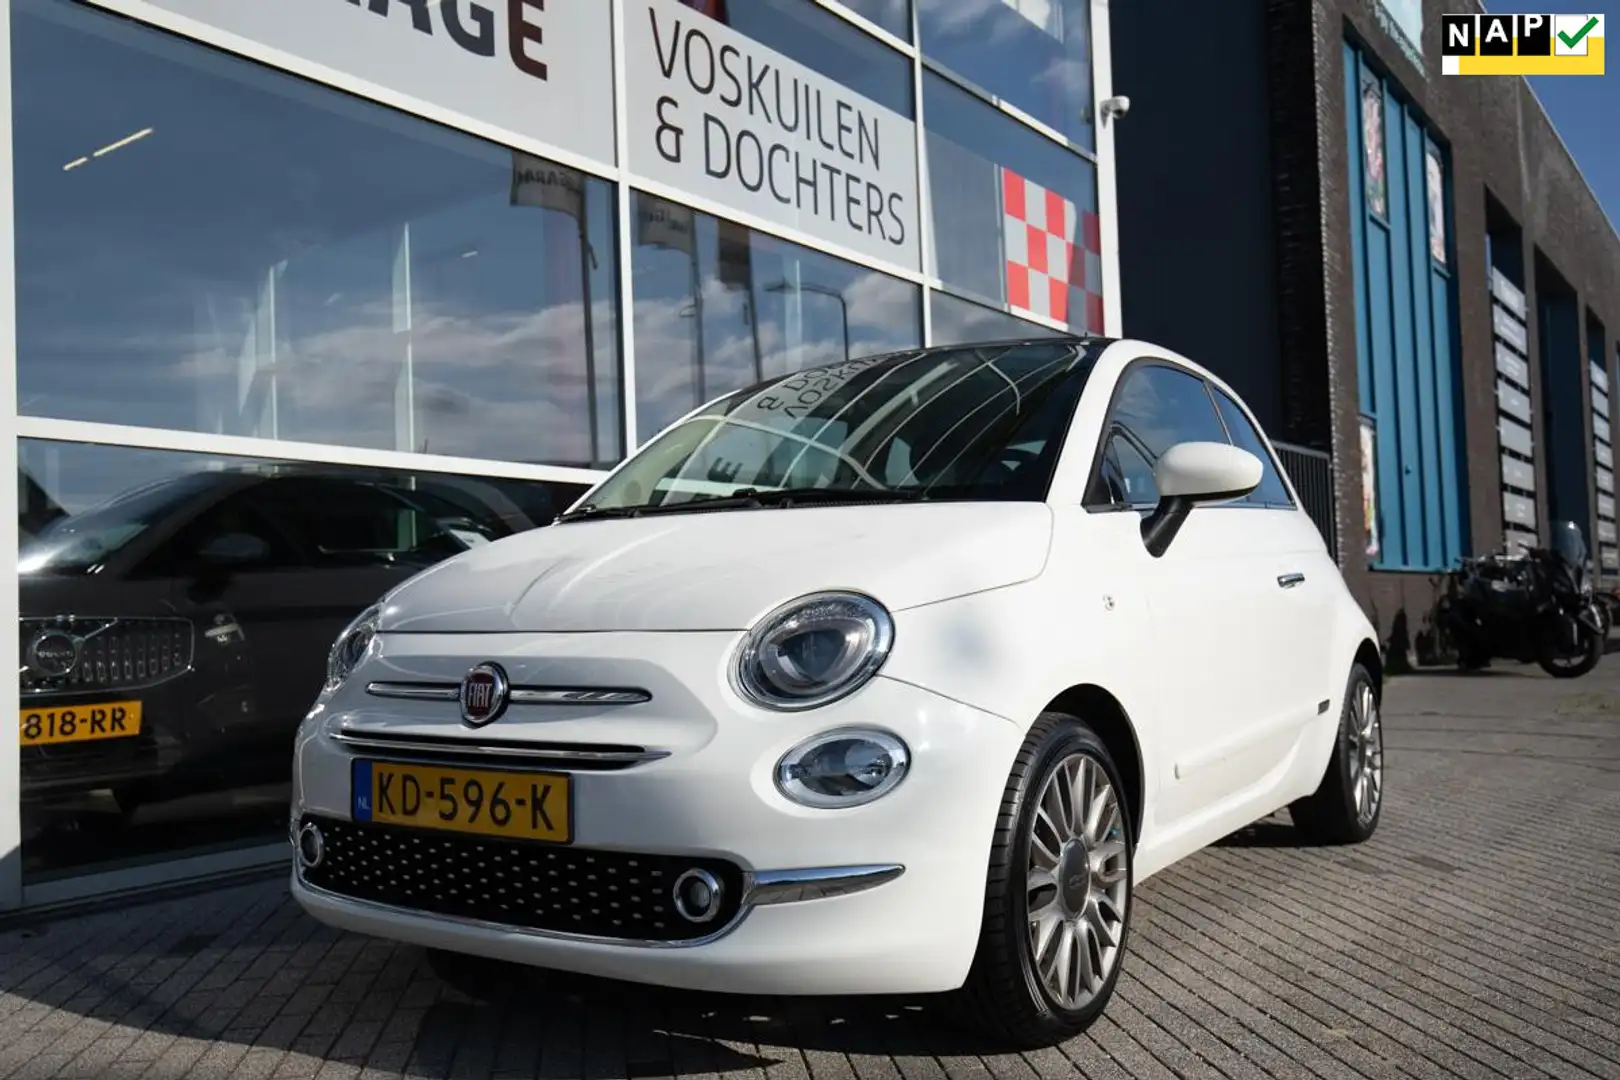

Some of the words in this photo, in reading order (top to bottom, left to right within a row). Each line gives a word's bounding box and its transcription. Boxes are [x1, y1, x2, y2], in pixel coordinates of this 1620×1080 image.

[648, 6, 880, 171] VOSKUILEN
[655, 95, 683, 163] &
[703, 112, 905, 245] DOCHTERS
[23, 707, 127, 739] 818-RR
[467, 683, 492, 708] FIAT
[357, 797, 371, 810] NL
[378, 772, 554, 831] KD-596-K
